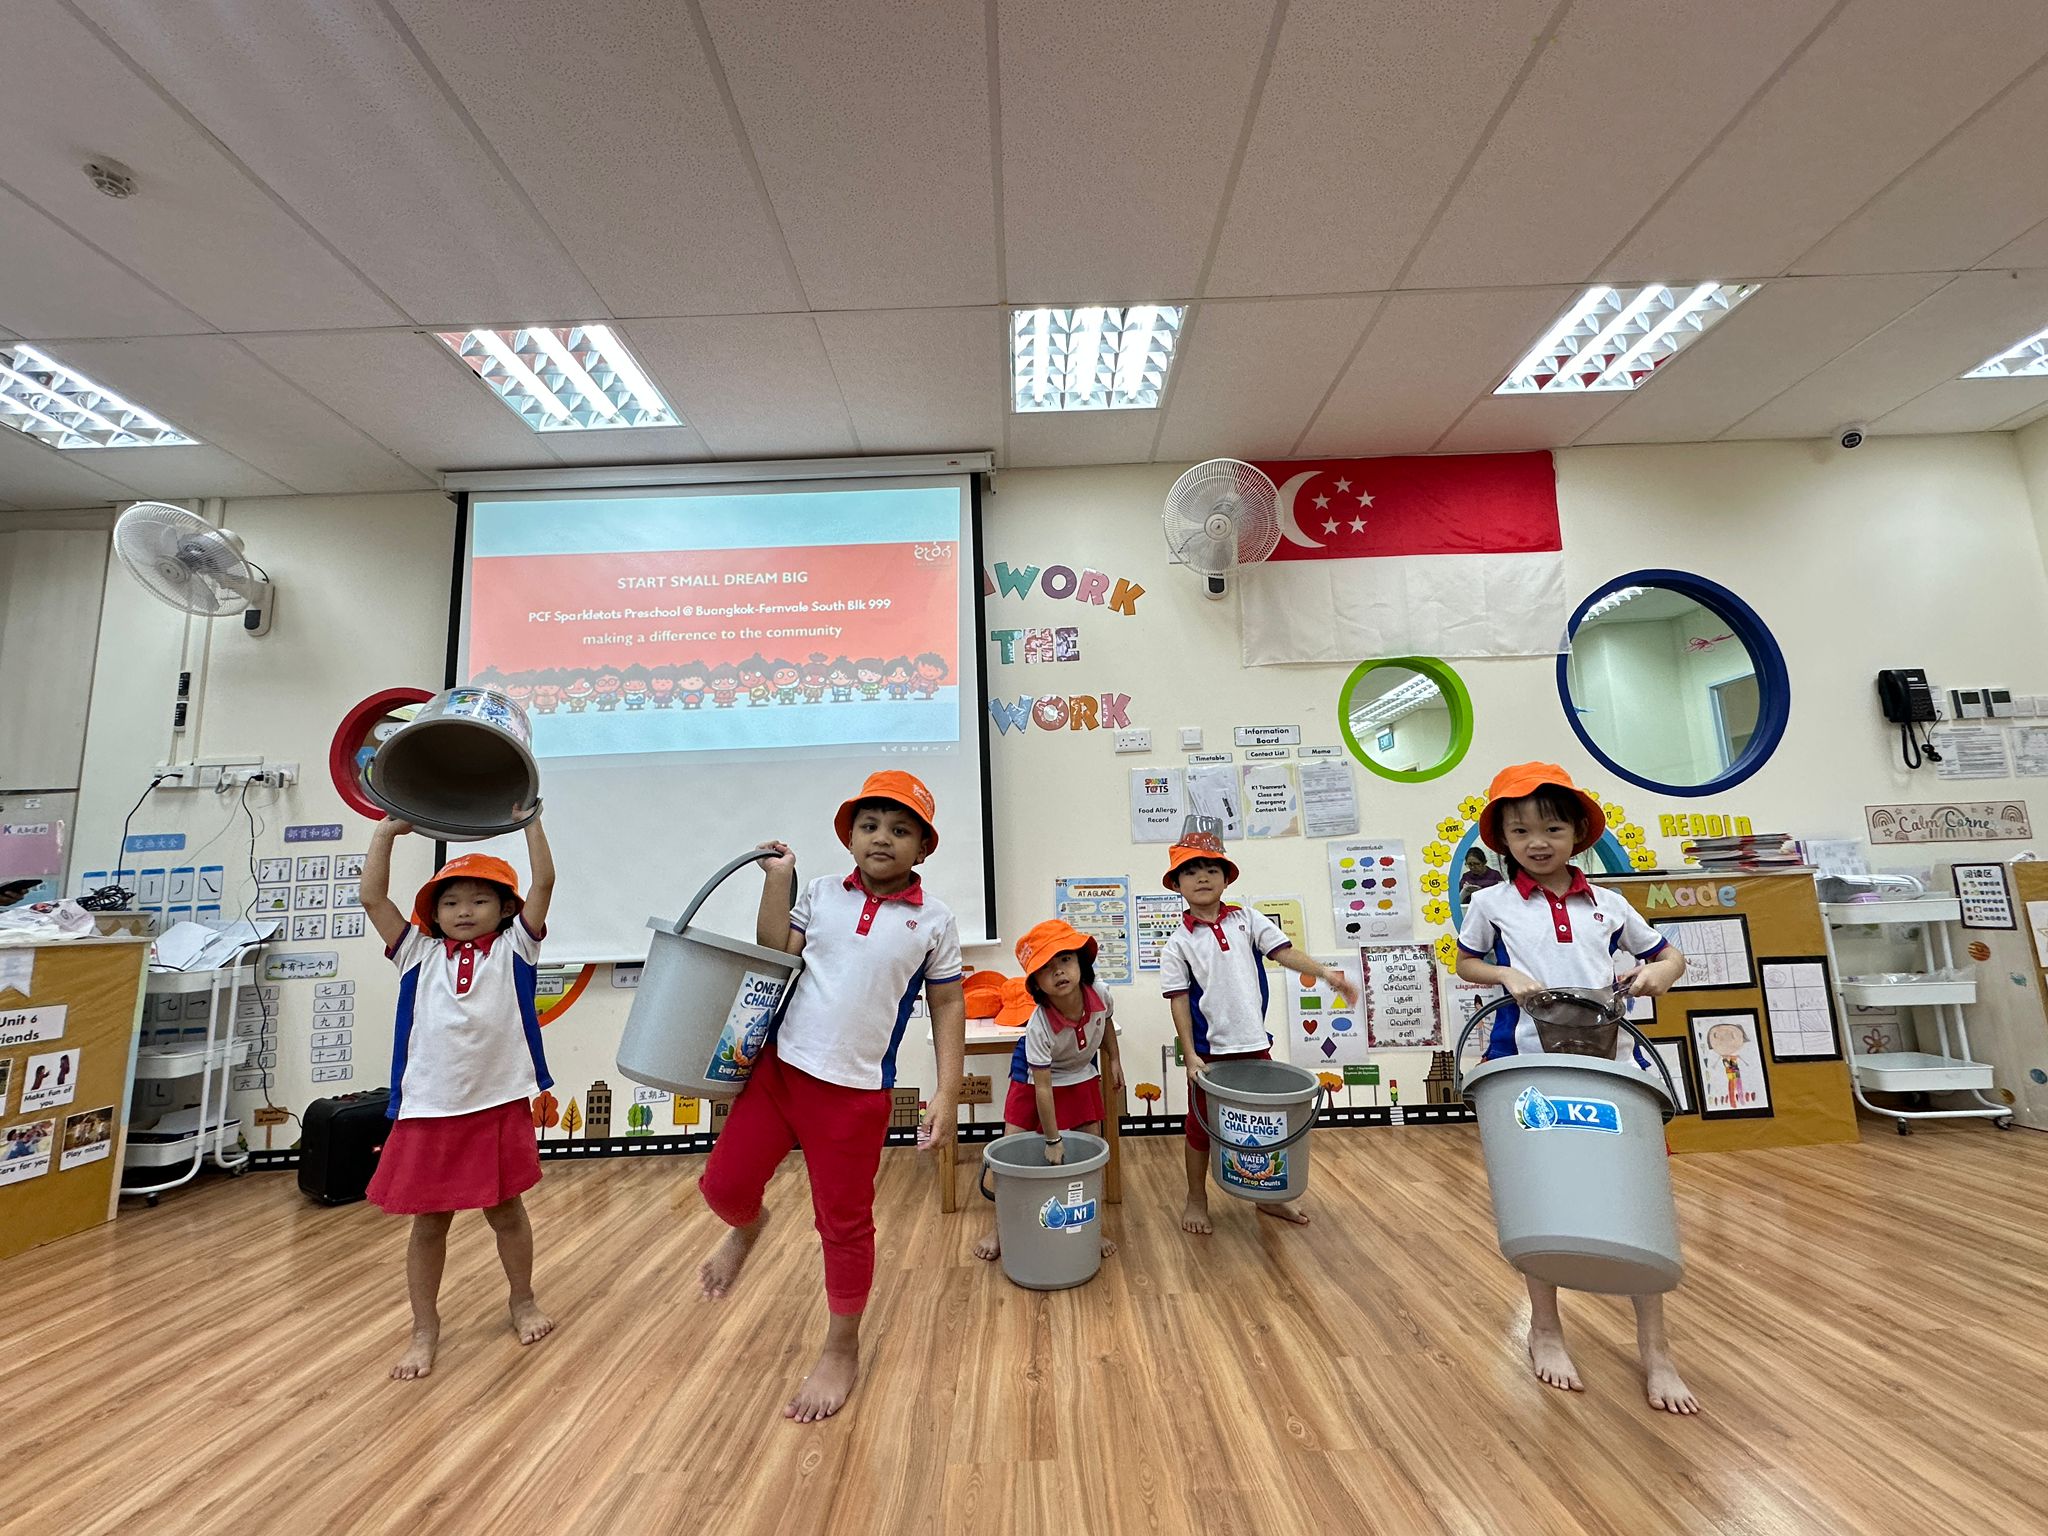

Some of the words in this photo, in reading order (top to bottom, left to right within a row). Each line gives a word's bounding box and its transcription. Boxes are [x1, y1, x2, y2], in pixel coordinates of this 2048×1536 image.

[617, 576, 667, 590] START
[670, 575, 720, 588] SMALL
[724, 572, 778, 585] DREAM
[782, 571, 808, 584] BIG
[984, 561, 1146, 616] WORK
[528, 611, 552, 622] PCF
[624, 606, 681, 619] Preschool
[682, 605, 693, 617] @
[695, 601, 809, 618] Buangkok-Fernvale
[811, 600, 845, 612] South
[848, 600, 865, 611] Blk
[868, 598, 892, 609] 999
[583, 632, 633, 646] making
[637, 634, 645, 643] a
[649, 630, 717, 642] difference
[721, 629, 736, 640] to
[740, 627, 761, 639] the
[766, 624, 843, 639] community
[991, 627, 1080, 664] THE
[988, 693, 1132, 735] WORK
[1900, 816, 1941, 833] Calm
[1092, 889, 1116, 897] GLANCE
[1646, 881, 1738, 909] Made
[268, 960, 334, 972] 一年有十二个月
[754, 980, 776, 995] ONE
[744, 993, 780, 1008] CHALLE
[30, 1015, 38, 1024] 6
[718, 1065, 737, 1077] Every
[24, 1091, 45, 1103] Make
[40, 1099, 54, 1109] you
[1227, 1111, 1247, 1124] ONE
[1250, 1116, 1273, 1126] PAIL
[1567, 1103, 1600, 1123] K2
[1224, 1119, 1279, 1136] CHALLENGE
[66, 1149, 82, 1159] Play
[1240, 1154, 1265, 1164] WATER
[19, 1161, 31, 1171] for
[34, 1158, 48, 1169] you
[1227, 1172, 1243, 1183] Every
[1243, 1175, 1259, 1186] Drop
[1260, 1177, 1281, 1187] Counts
[1073, 1209, 1087, 1221] N1
